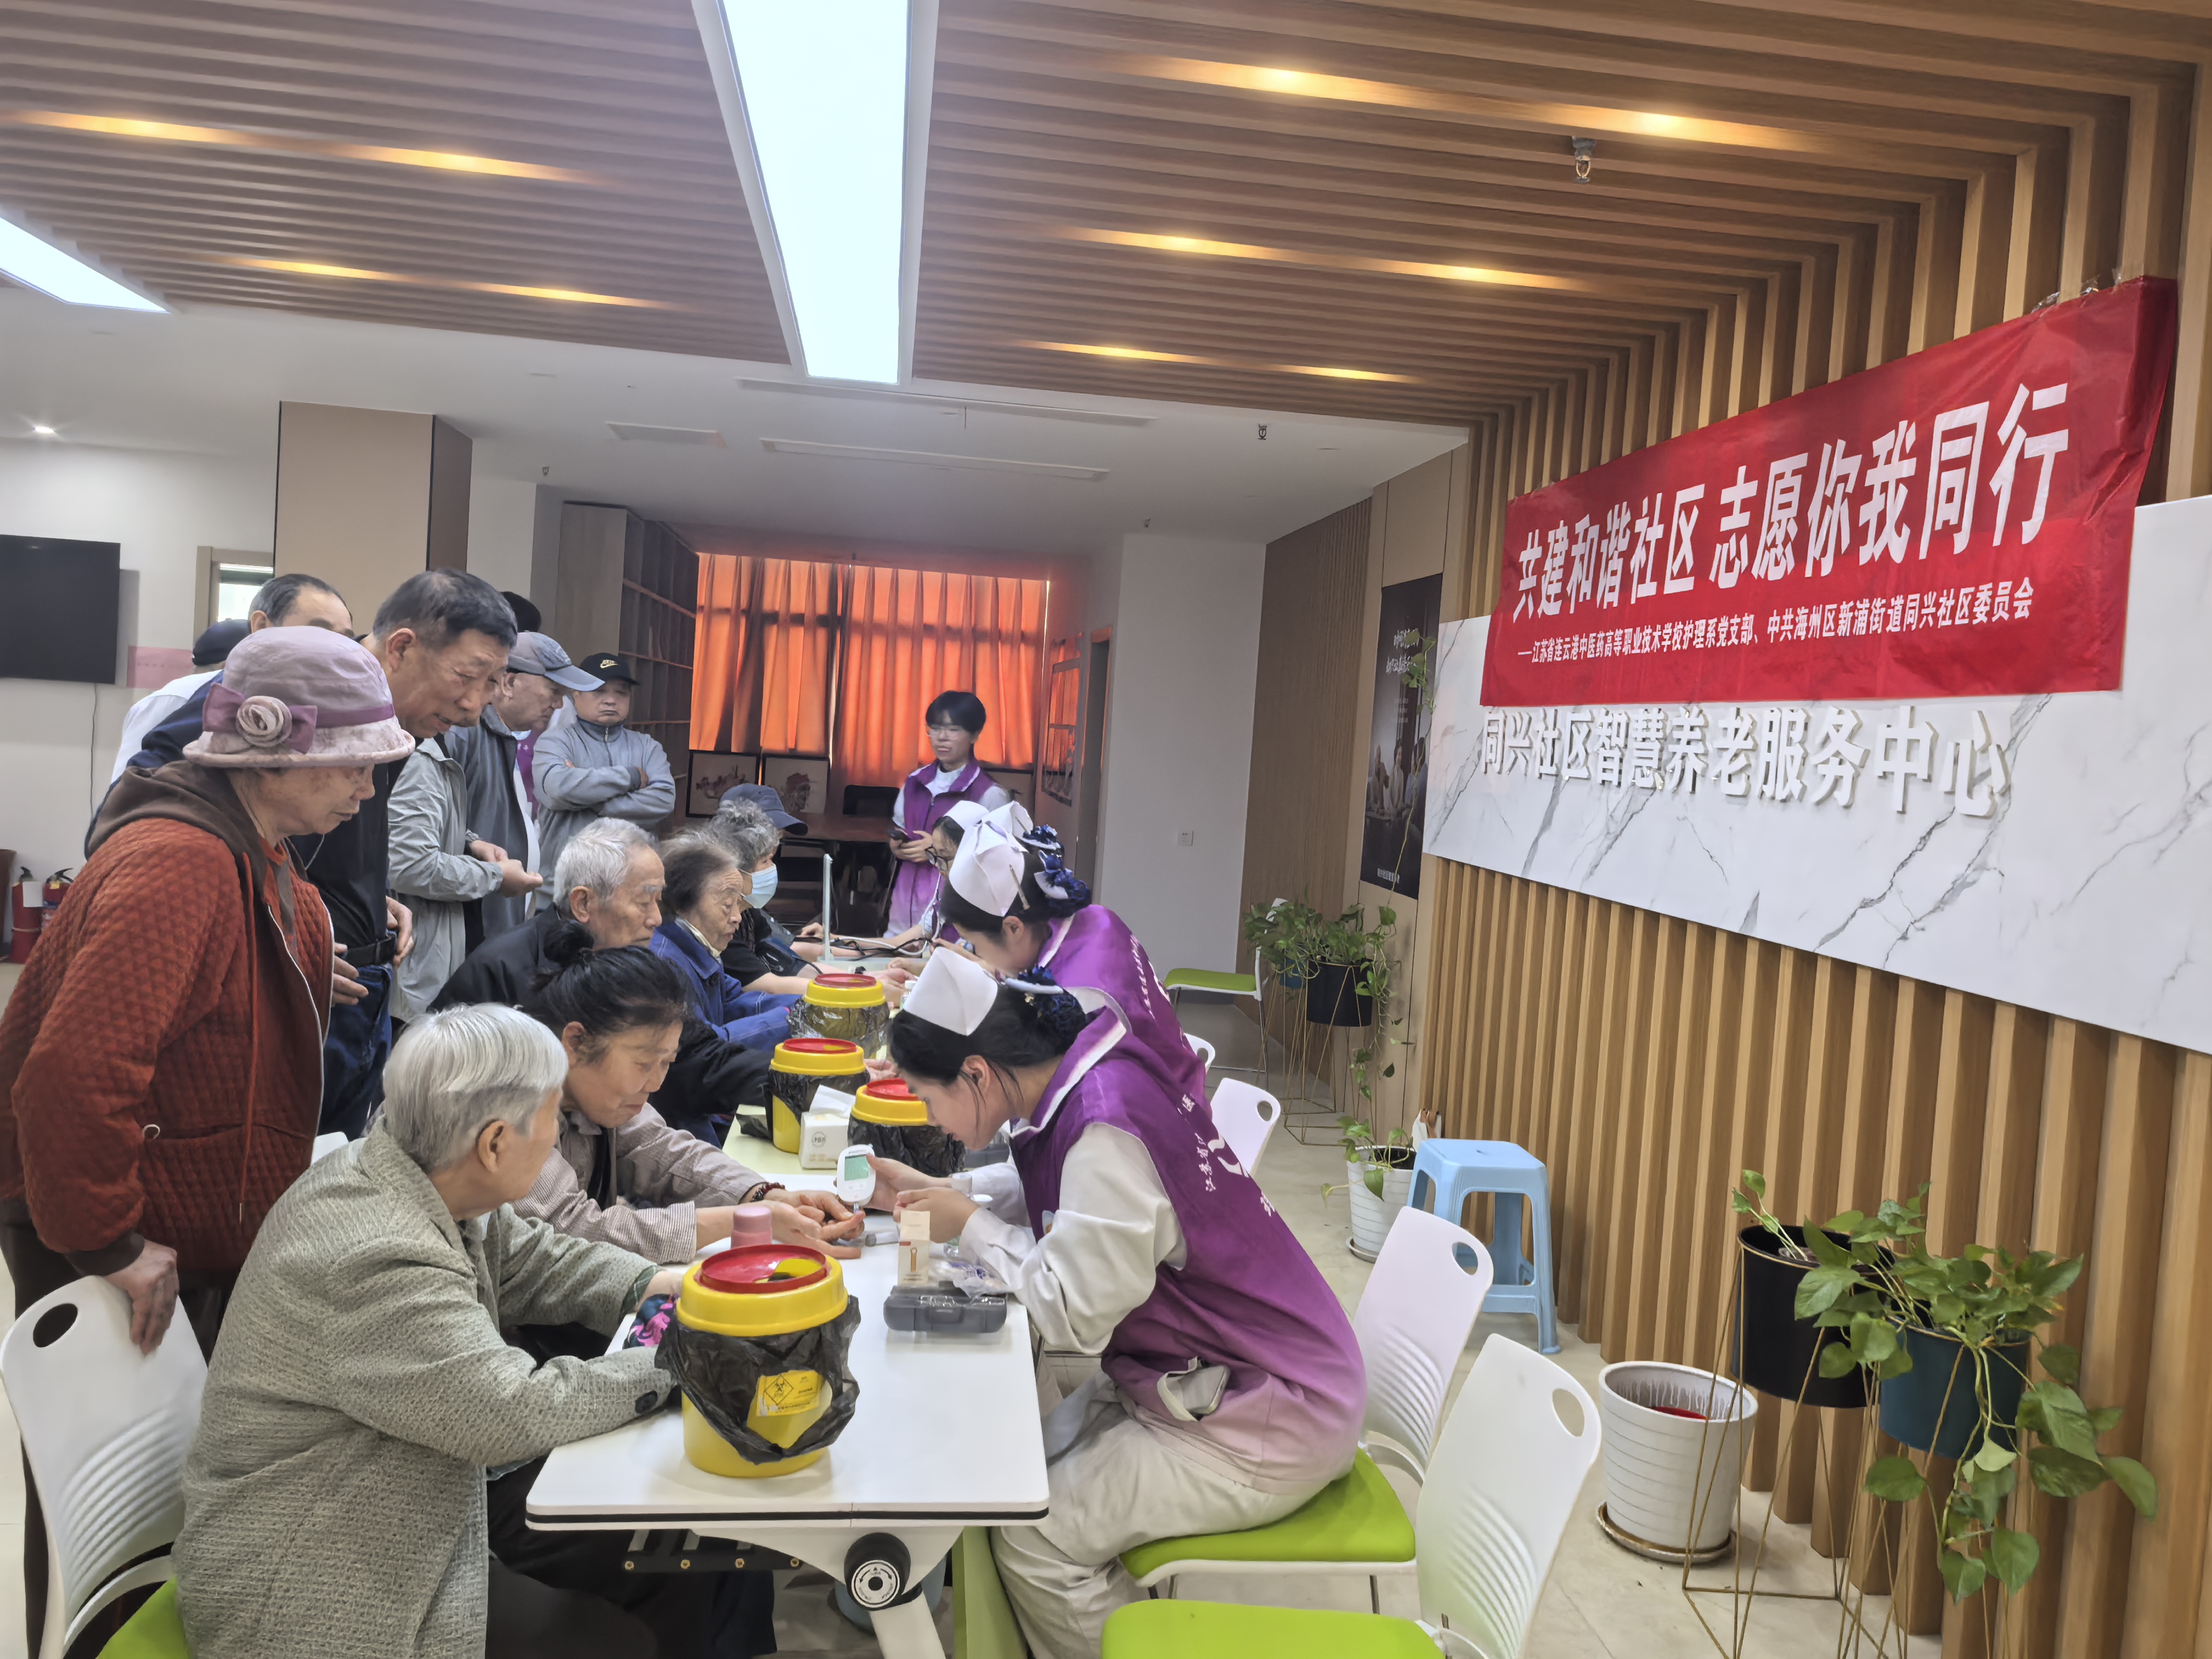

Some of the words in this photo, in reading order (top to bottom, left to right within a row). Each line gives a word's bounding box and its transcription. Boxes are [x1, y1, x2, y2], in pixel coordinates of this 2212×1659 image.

[1513, 483, 1705, 624] 共建和谐社区
[1709, 383, 2069, 589] 志愿你我同行
[1481, 706, 2009, 818] 同兴社区智慧养老服务中心
